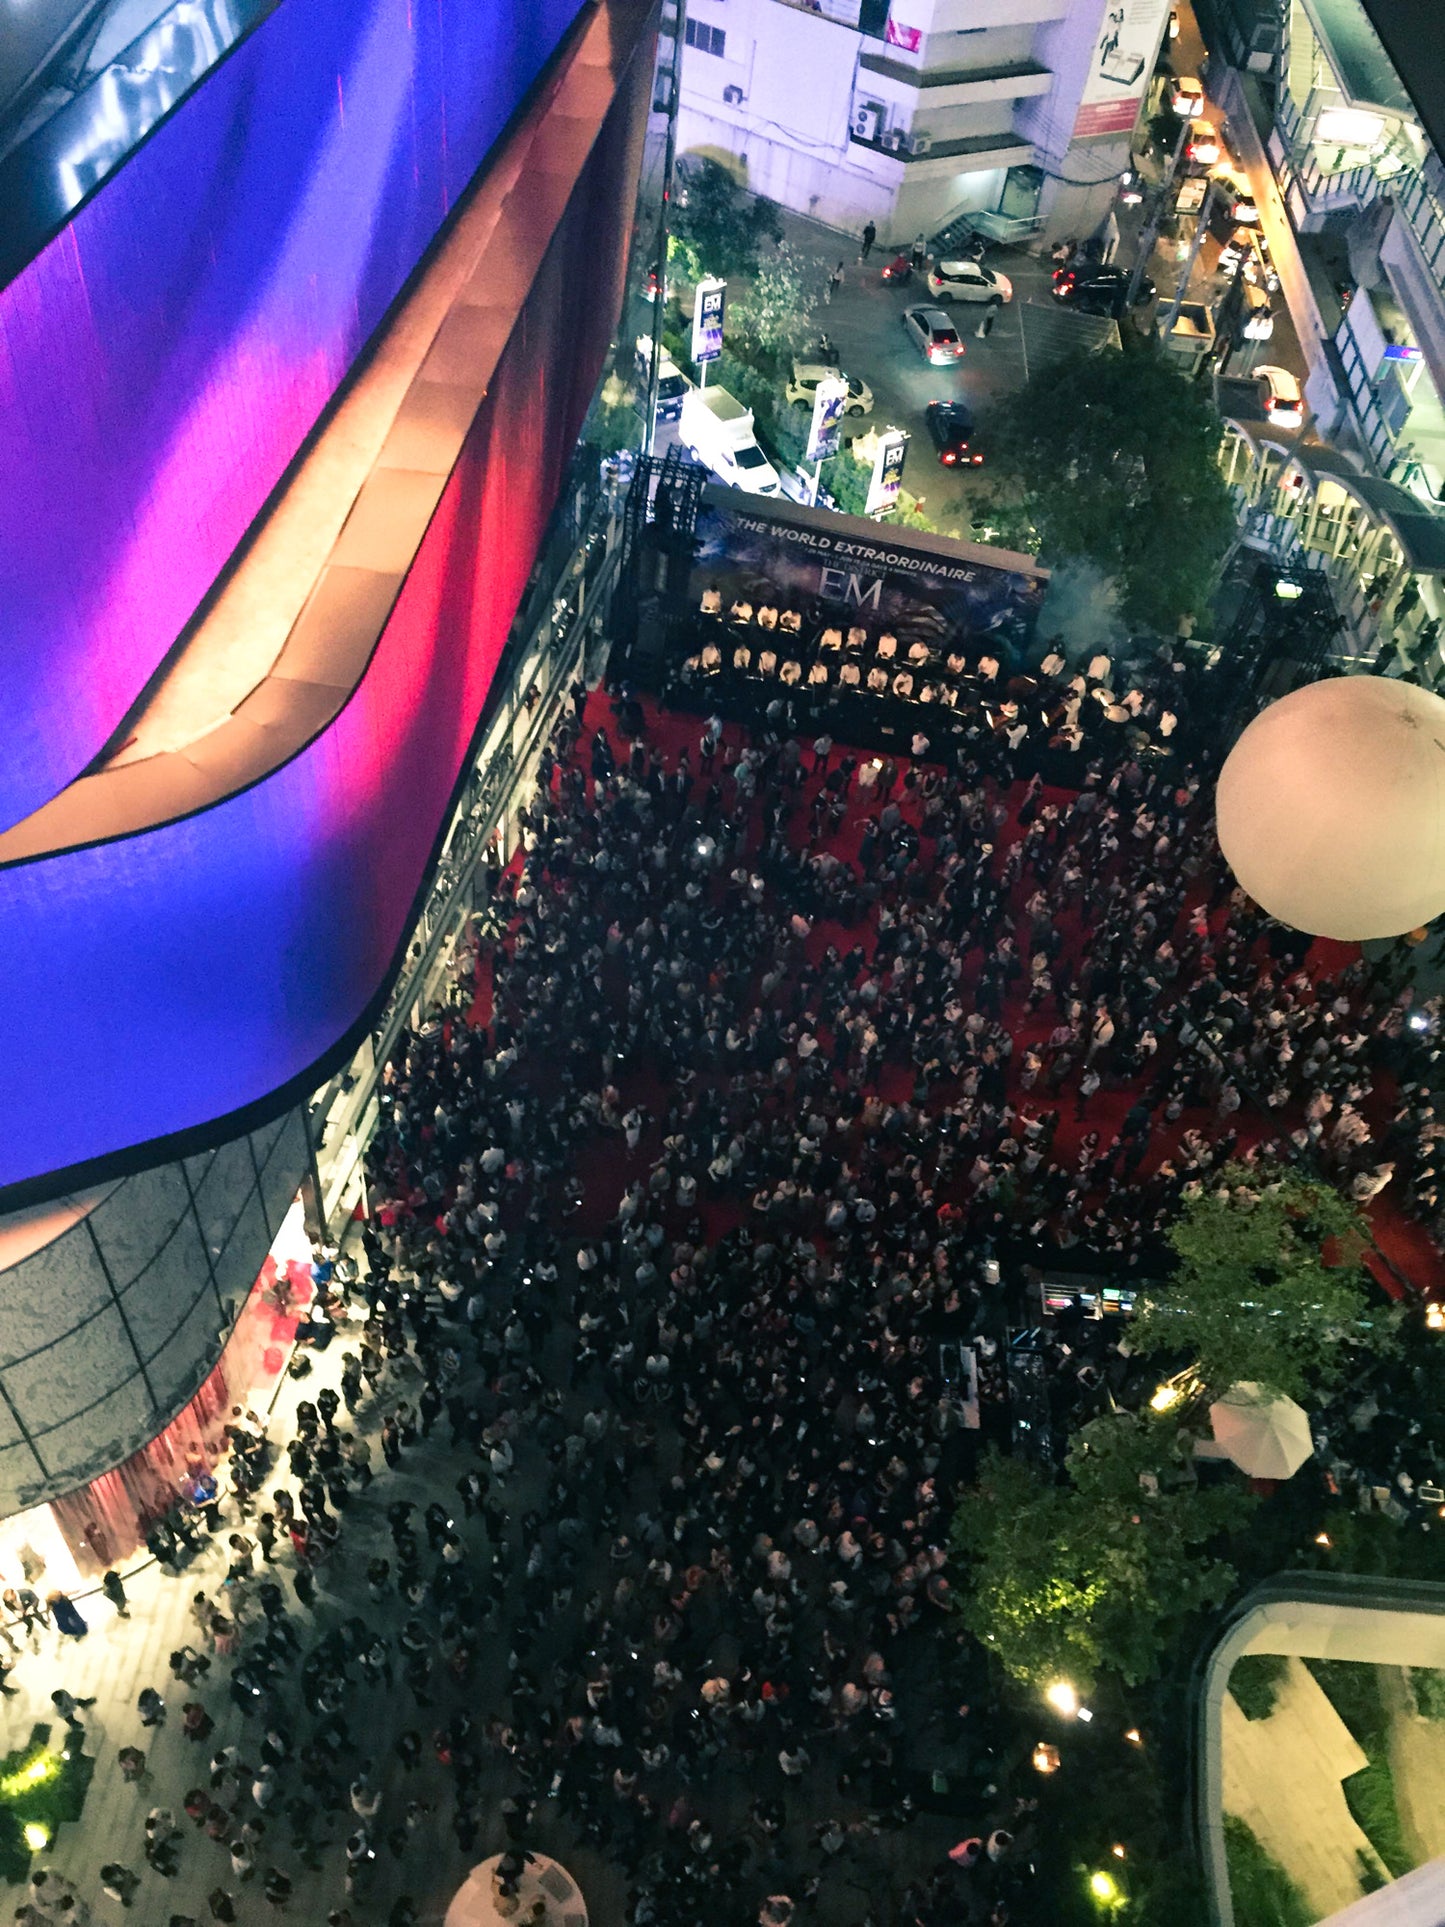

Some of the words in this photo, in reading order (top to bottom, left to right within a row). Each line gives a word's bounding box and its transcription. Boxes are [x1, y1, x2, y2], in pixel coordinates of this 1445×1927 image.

[885, 445, 905, 467] EM
[737, 518, 767, 533] THE
[771, 525, 831, 548] WORLD
[834, 541, 976, 582] EXTRAORDINAIRE
[819, 566, 884, 610] EM
